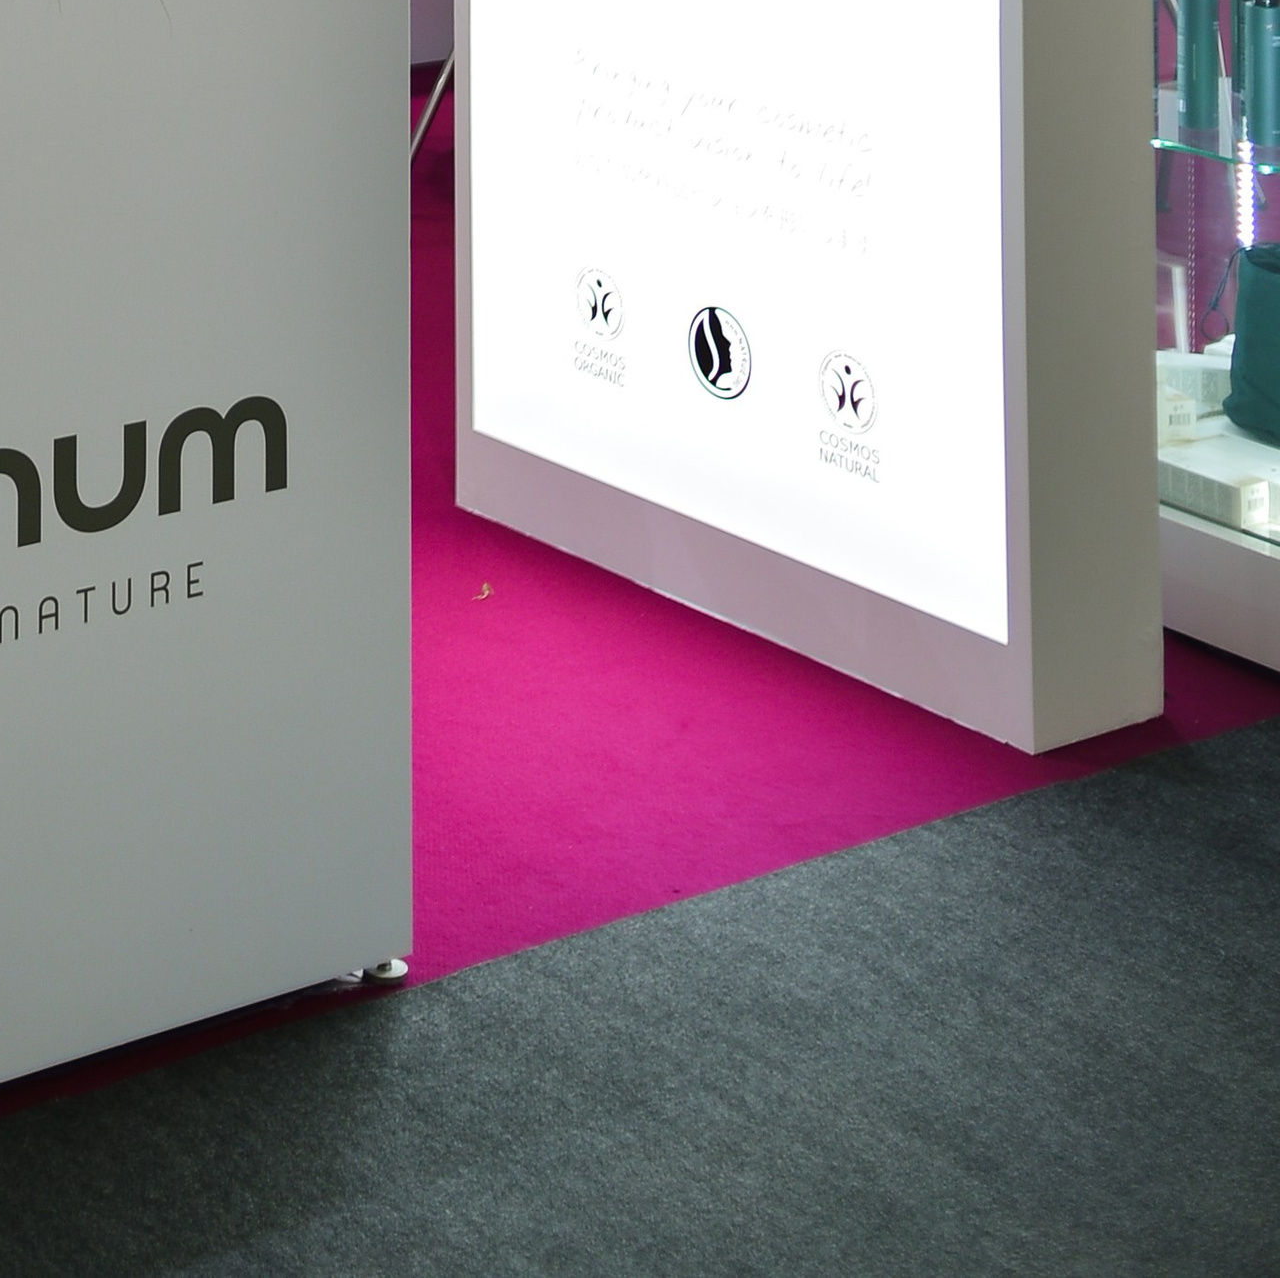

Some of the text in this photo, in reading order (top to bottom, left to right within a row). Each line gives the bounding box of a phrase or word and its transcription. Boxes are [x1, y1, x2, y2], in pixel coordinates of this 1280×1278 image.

[574, 340, 627, 371] COSMOS
[574, 356, 626, 388] ORGANIC
[819, 429, 880, 465] COSMOS
[819, 447, 880, 484] NATURAL
